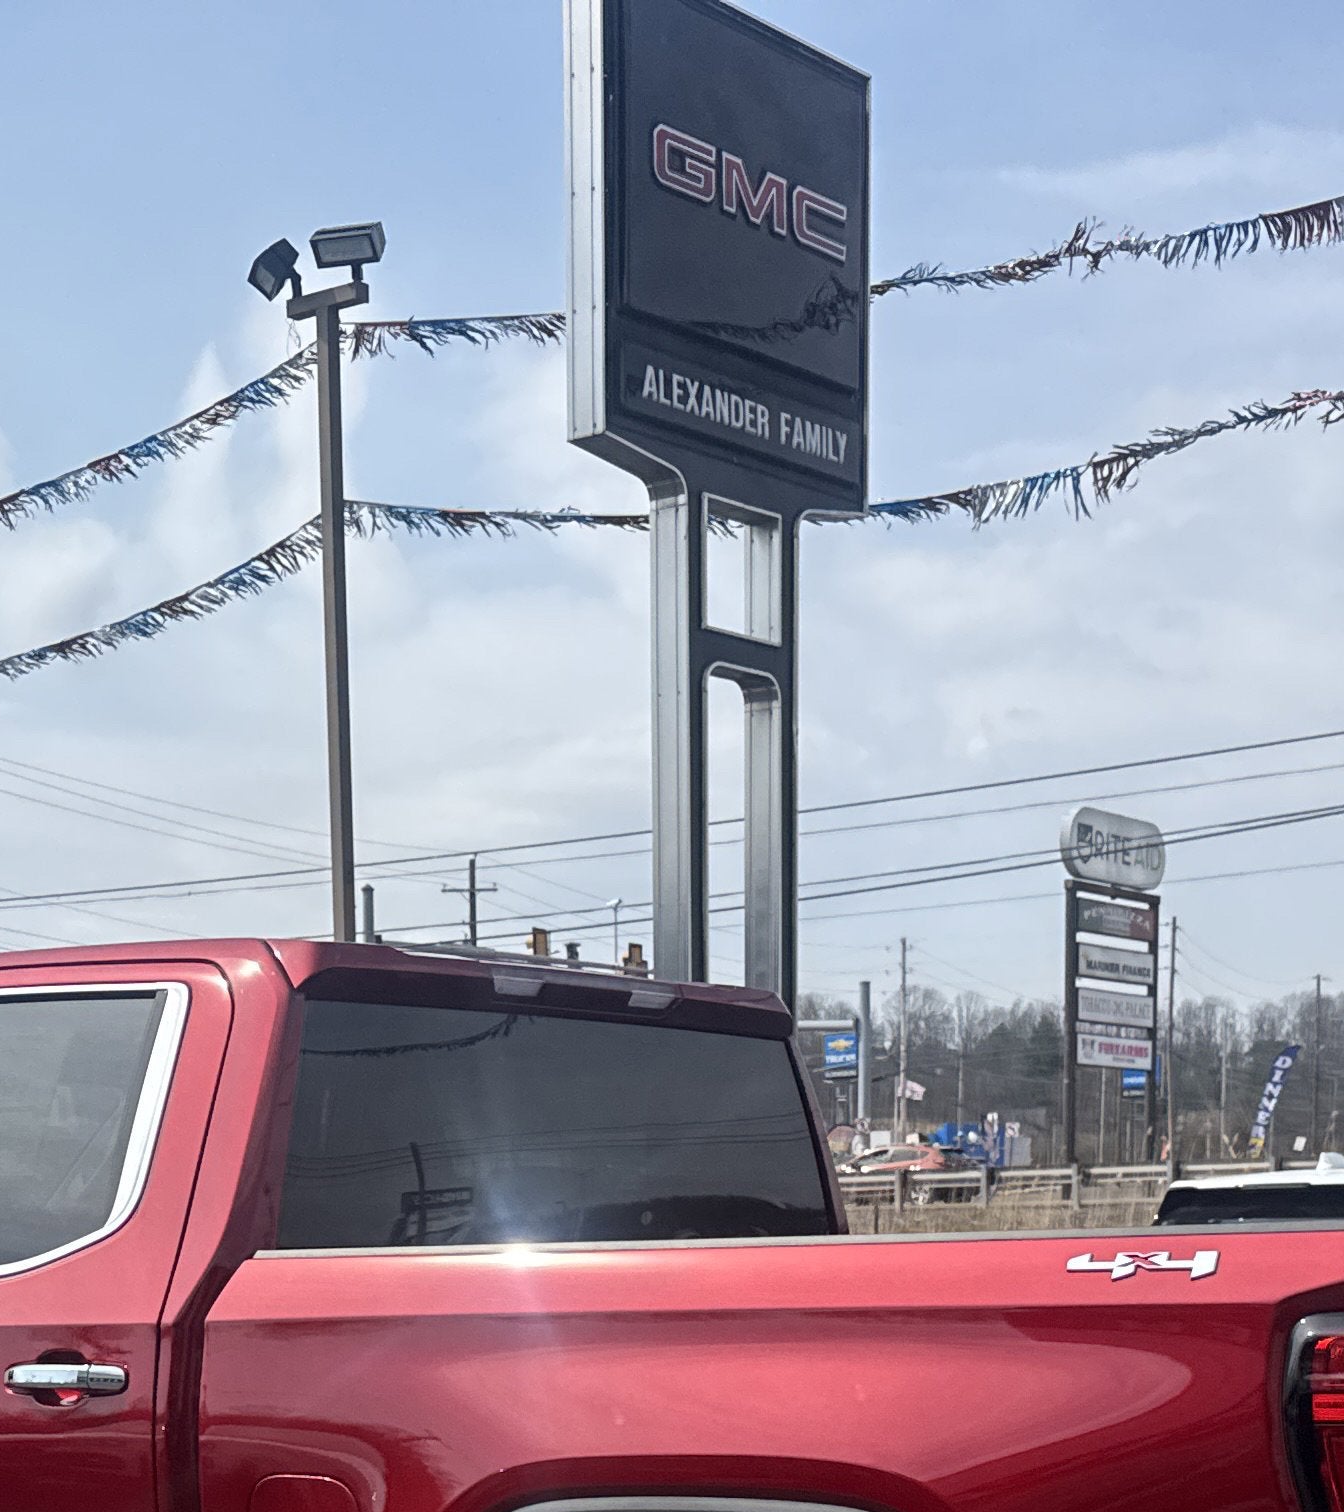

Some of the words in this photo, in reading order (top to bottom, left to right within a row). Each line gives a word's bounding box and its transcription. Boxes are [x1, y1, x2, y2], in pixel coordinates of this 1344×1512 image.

[653, 124, 847, 262] GMC
[642, 365, 770, 440] ALEXANDER
[779, 412, 848, 465] FAMILY
